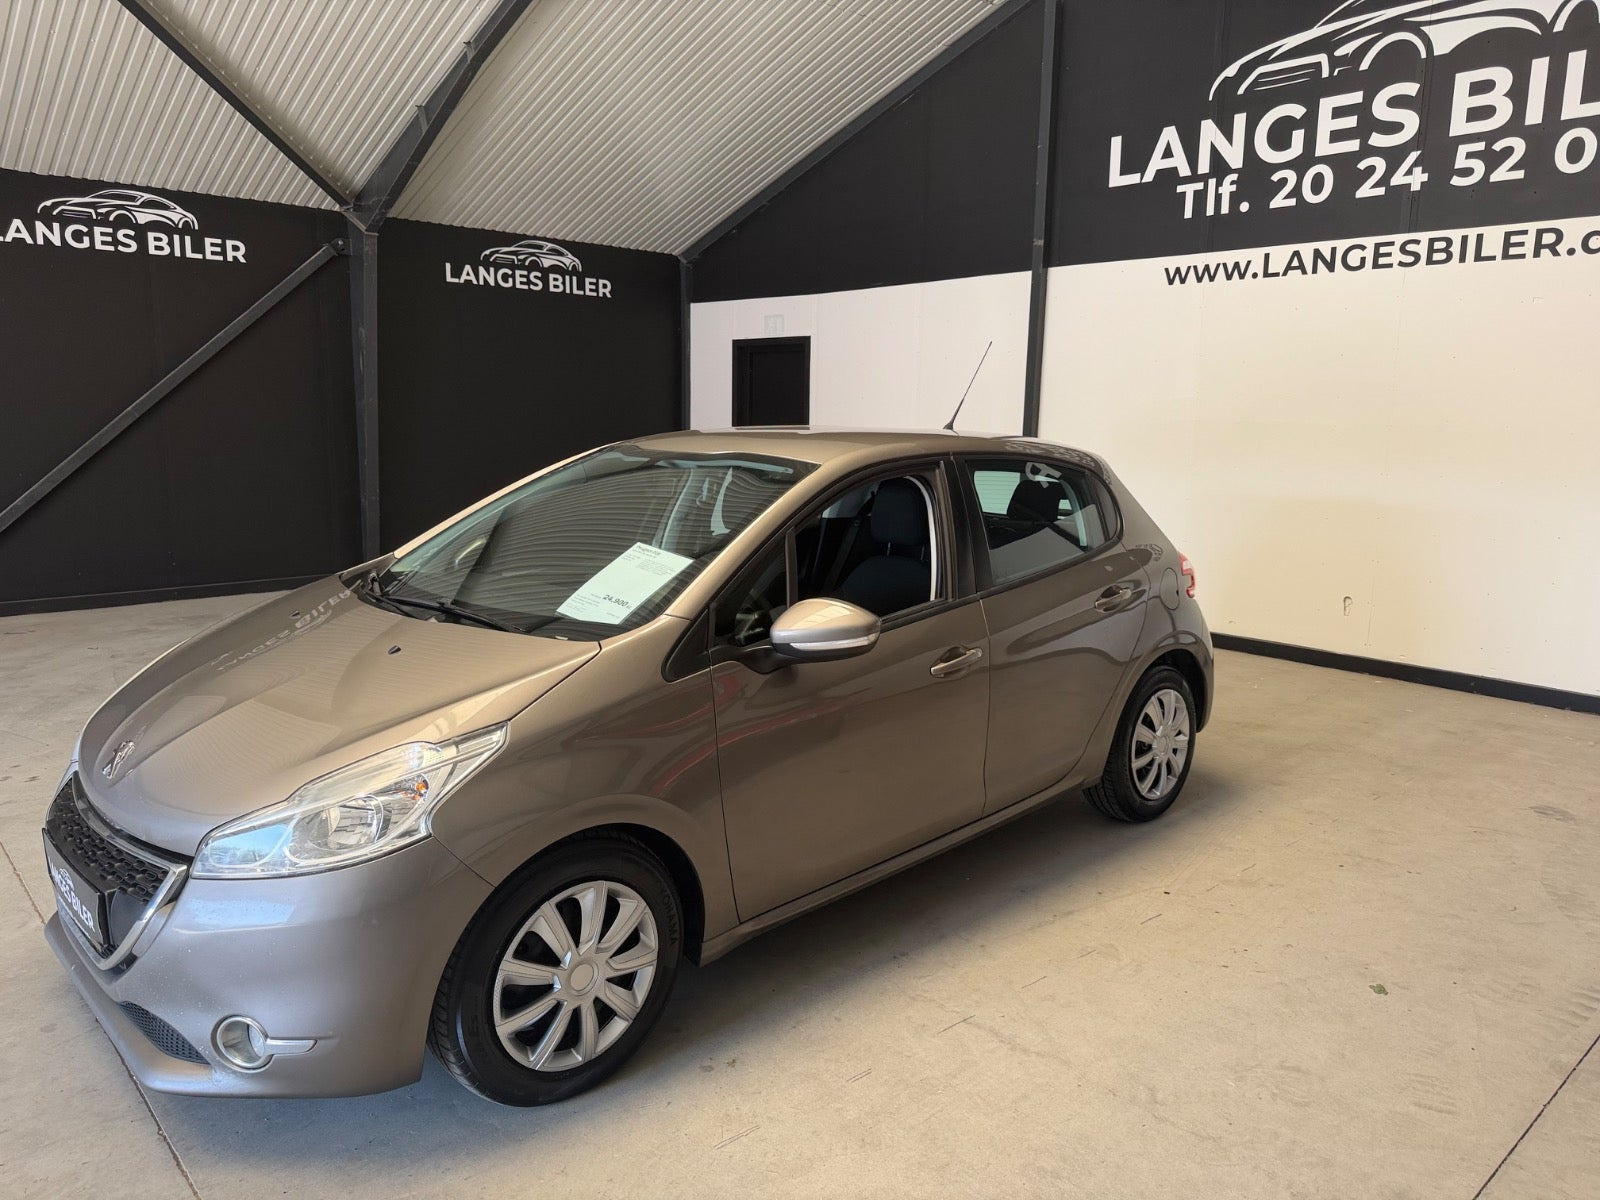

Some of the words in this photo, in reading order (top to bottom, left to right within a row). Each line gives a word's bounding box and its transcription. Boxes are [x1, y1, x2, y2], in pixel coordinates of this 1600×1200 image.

[1108, 82, 1421, 188] LANGES
[1176, 174, 1250, 219] Tlf.
[1268, 164, 1334, 209] 20
[1354, 151, 1429, 199] 24
[1449, 137, 1527, 187] 52
[1554, 127, 1598, 174] 0
[0, 218, 138, 253] ANGES
[147, 231, 247, 263] BILER
[445, 262, 543, 291] LANGES
[549, 273, 612, 298] BILER
